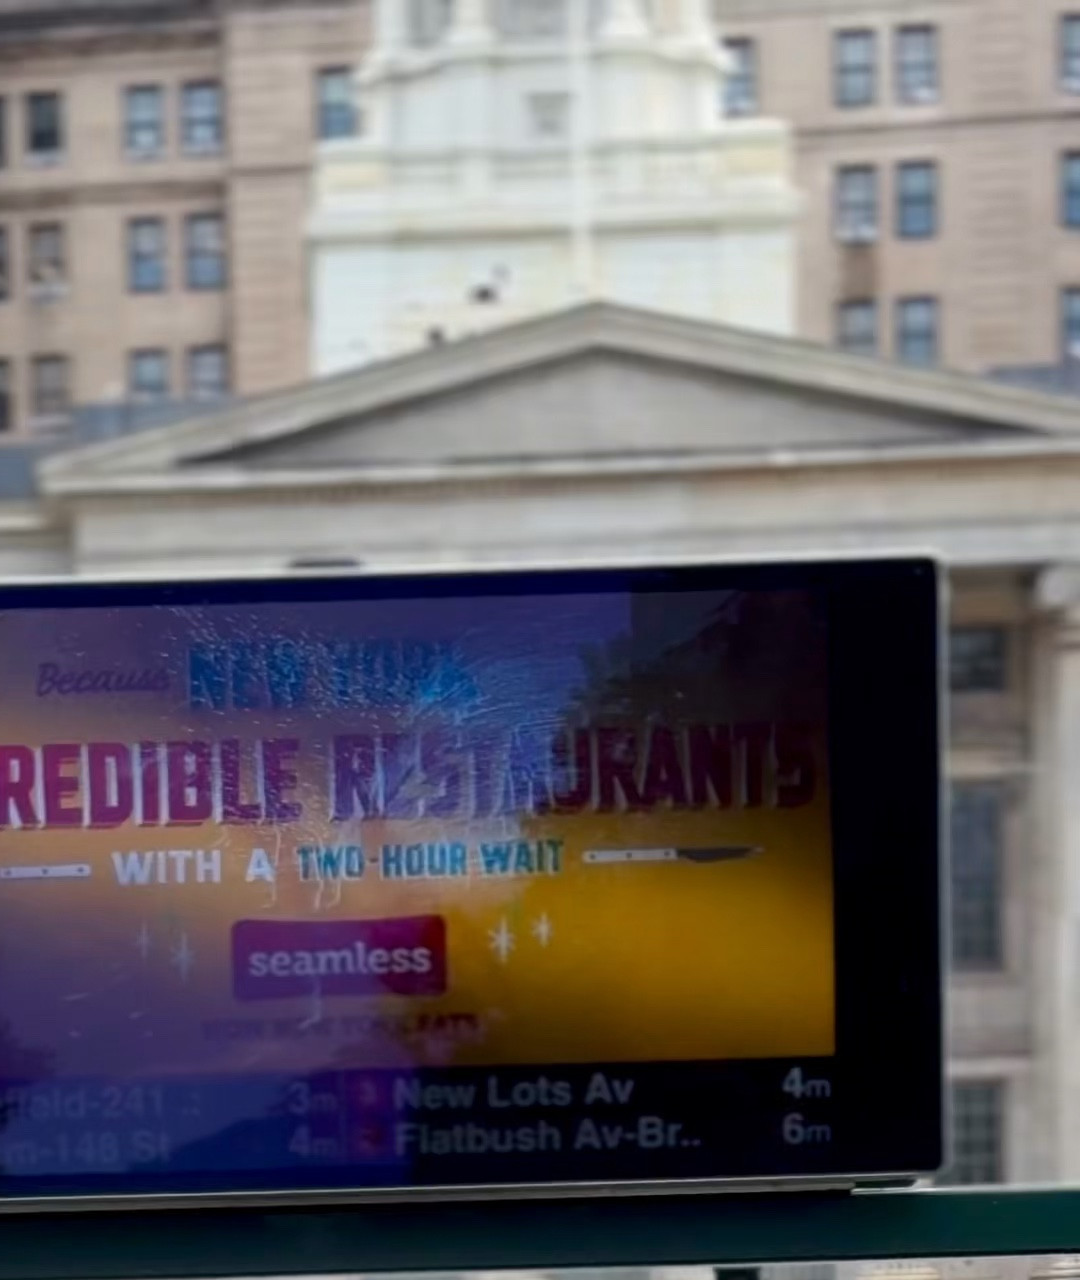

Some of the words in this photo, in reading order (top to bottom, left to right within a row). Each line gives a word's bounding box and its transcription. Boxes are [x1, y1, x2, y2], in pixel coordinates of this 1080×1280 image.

[112, 850, 220, 885] WITH
[246, 848, 276, 883] A
[295, 839, 467, 882] TWO-HOUR
[479, 837, 564, 876] WAIT
[249, 941, 433, 977] seamless
[394, 1078, 476, 1111] New
[487, 1076, 572, 1107] Lots
[584, 1073, 635, 1104] Av
[782, 1067, 832, 1098] 4m
[394, 1119, 562, 1155] Flatbush
[782, 1113, 832, 1145] 6m
